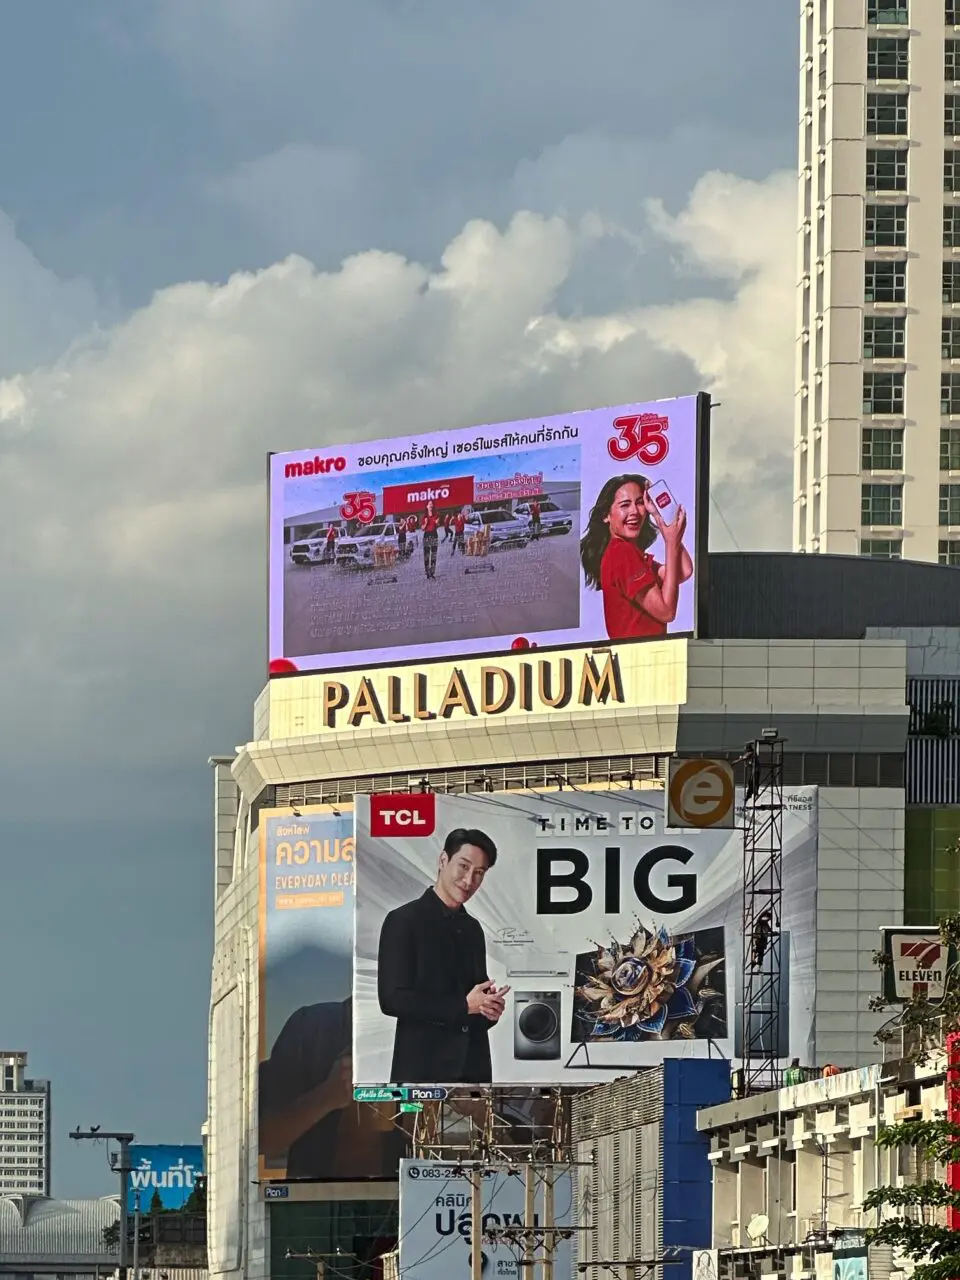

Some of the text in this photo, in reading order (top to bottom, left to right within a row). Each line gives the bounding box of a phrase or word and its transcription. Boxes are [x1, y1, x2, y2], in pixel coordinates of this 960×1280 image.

[358, 424, 579, 467] ขอบคุณครั้งใหญ่ เซอร์ไพรส์ให้คนที่รักกัน
[607, 414, 669, 466] 35
[285, 456, 346, 478] makro
[341, 491, 376, 524] 35
[407, 487, 450, 502] makro
[323, 650, 625, 728] PALLADIUM
[380, 809, 426, 826] TCL
[539, 815, 654, 833] TIME TO
[276, 874, 327, 890] EVERYDAY
[537, 844, 698, 915] BIG
[412, 1089, 440, 1099] Plan B
[130, 1158, 204, 1188] พื้นที่โ
